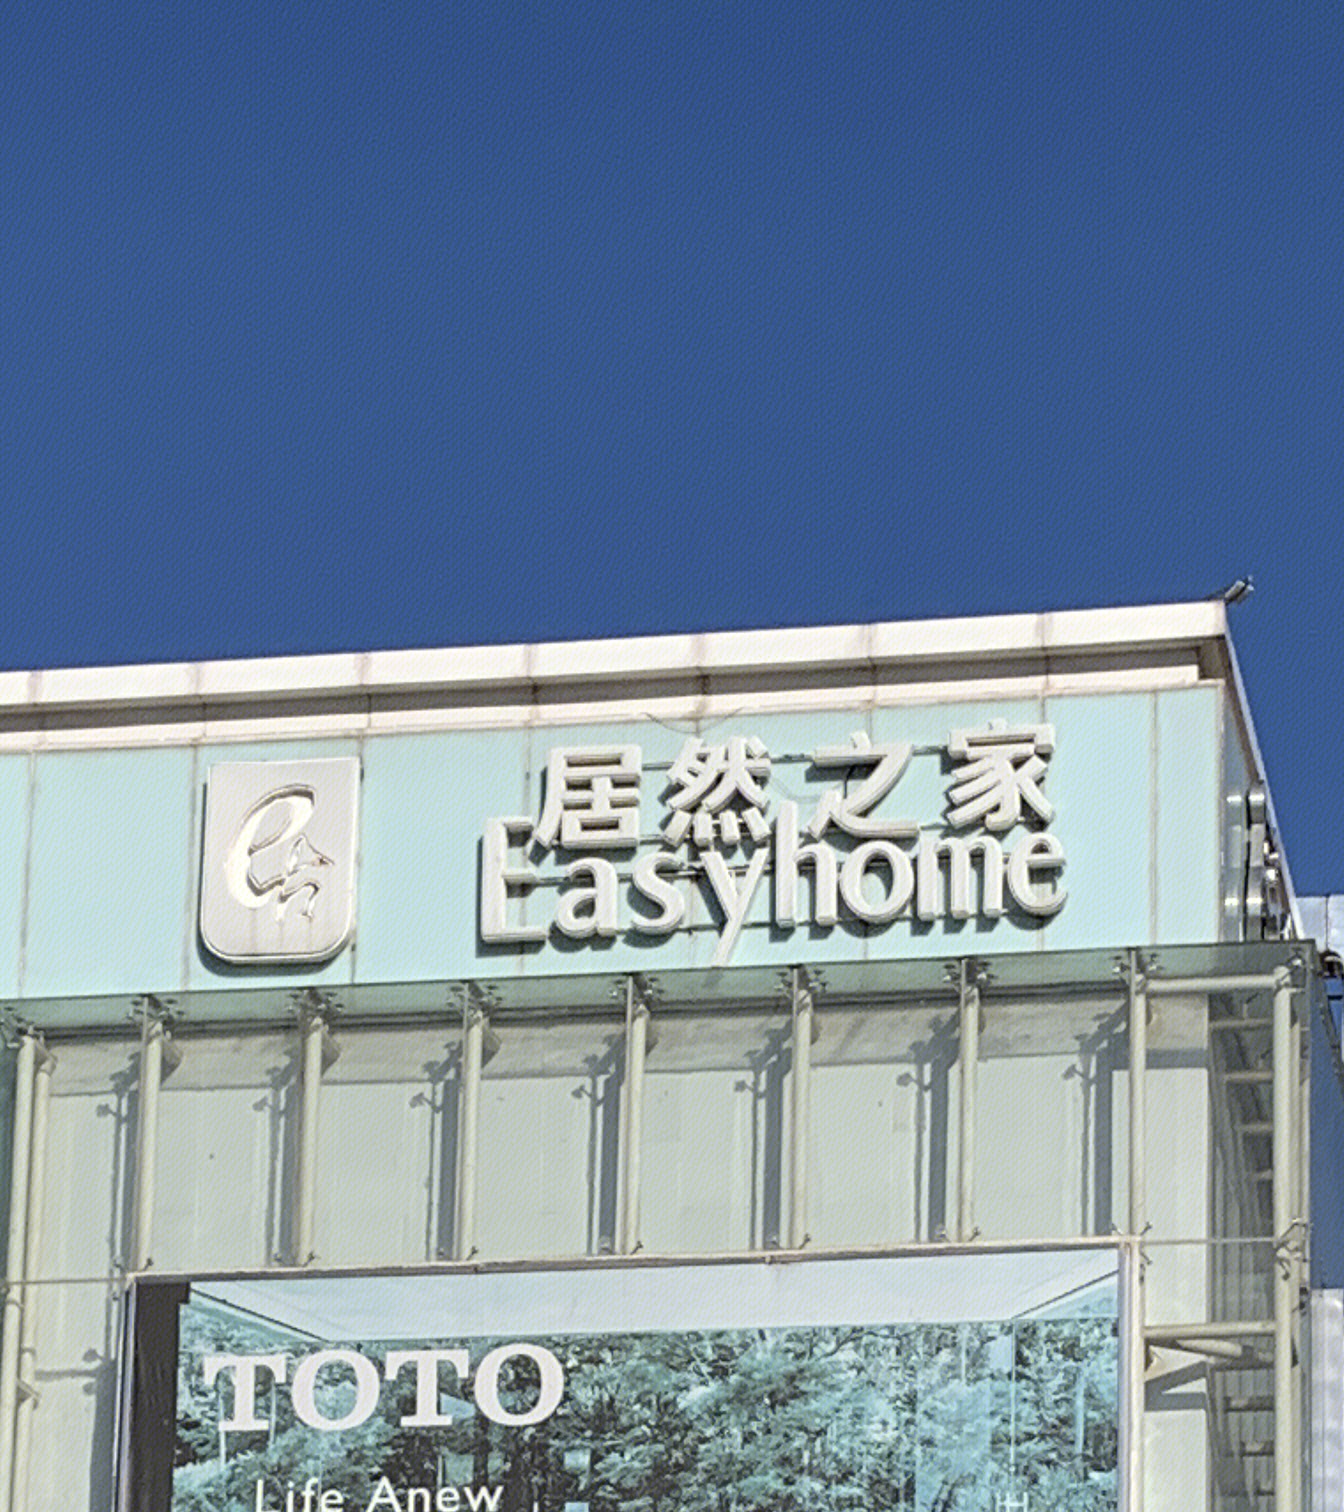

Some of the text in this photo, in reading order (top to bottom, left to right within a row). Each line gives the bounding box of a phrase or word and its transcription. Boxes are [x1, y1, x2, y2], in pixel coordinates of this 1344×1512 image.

[533, 719, 1055, 849] 居然之家
[480, 801, 1069, 966] Easyhome
[203, 1343, 566, 1434] TOTO
